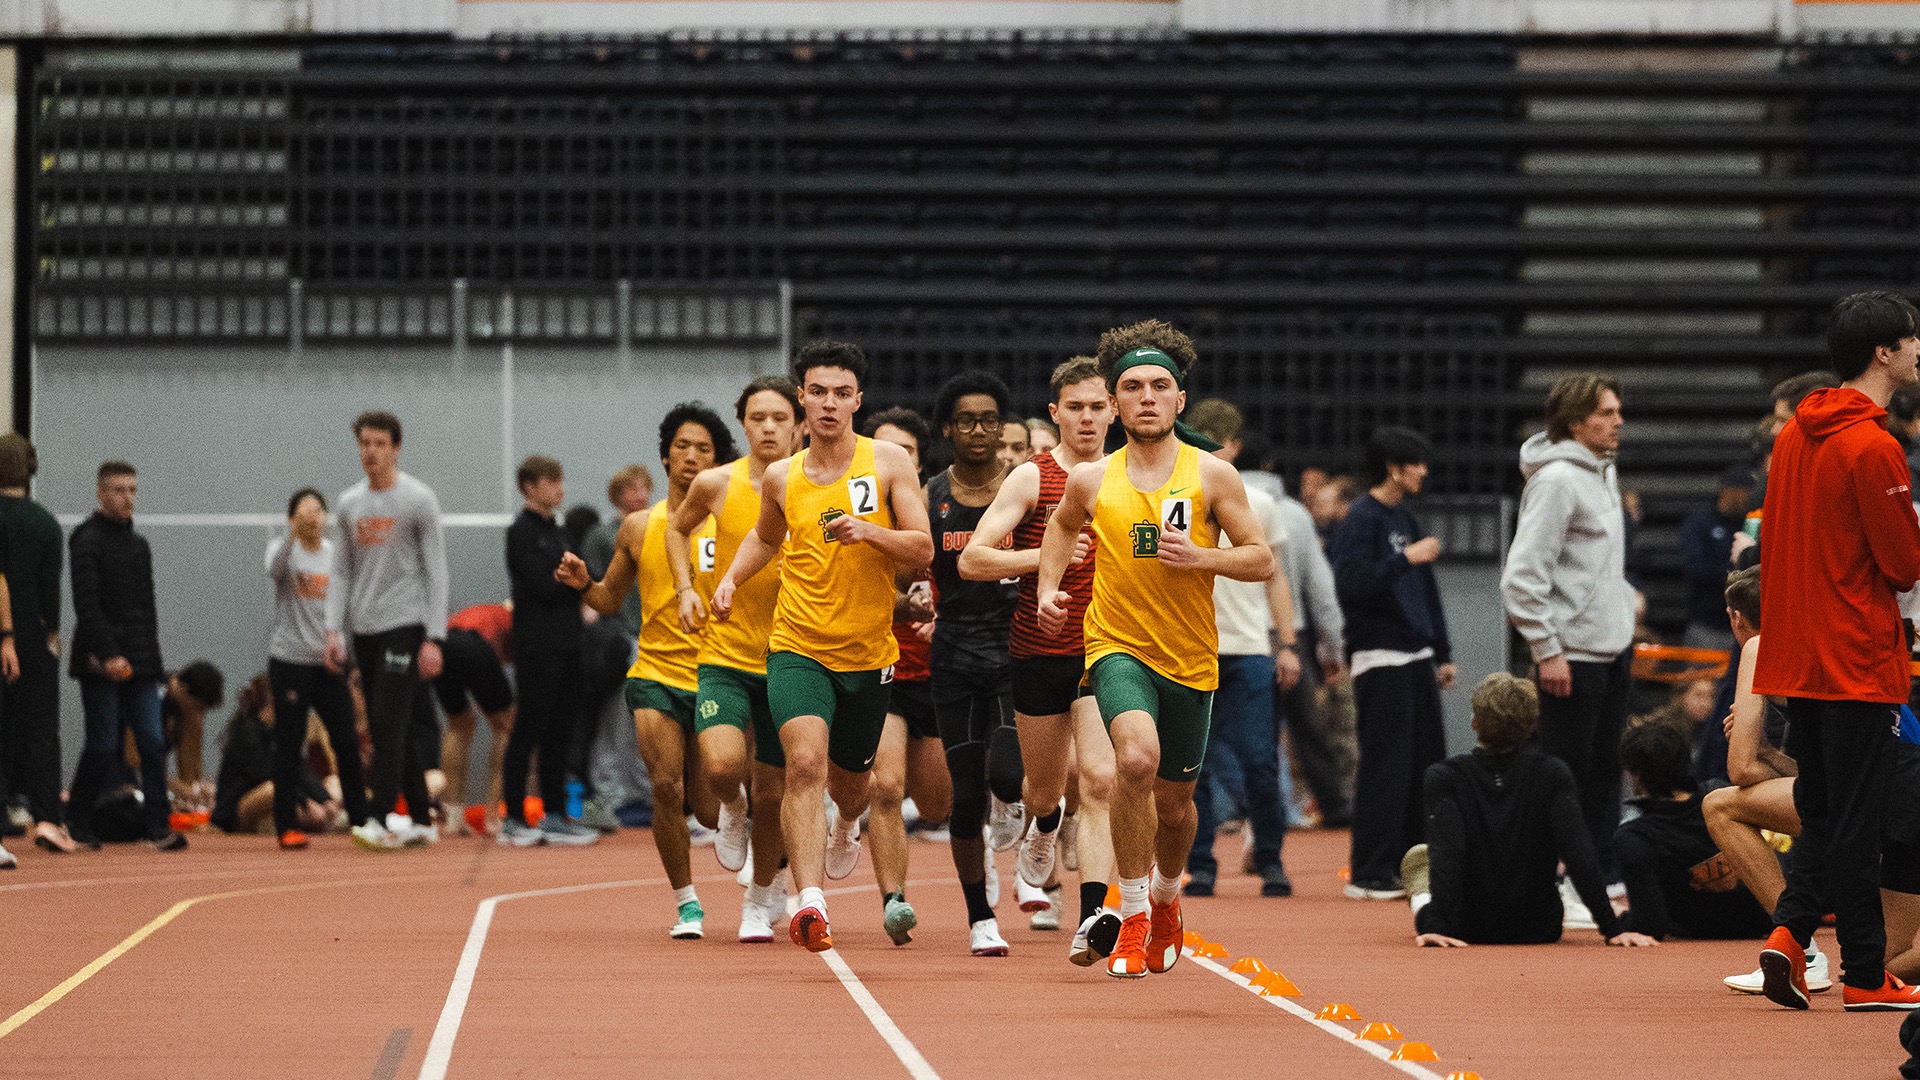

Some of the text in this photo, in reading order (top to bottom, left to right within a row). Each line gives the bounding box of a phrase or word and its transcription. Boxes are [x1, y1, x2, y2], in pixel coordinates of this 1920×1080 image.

[853, 480, 874, 513] 2
[1167, 501, 1187, 532] 4
[943, 531, 1014, 551] BUFO
